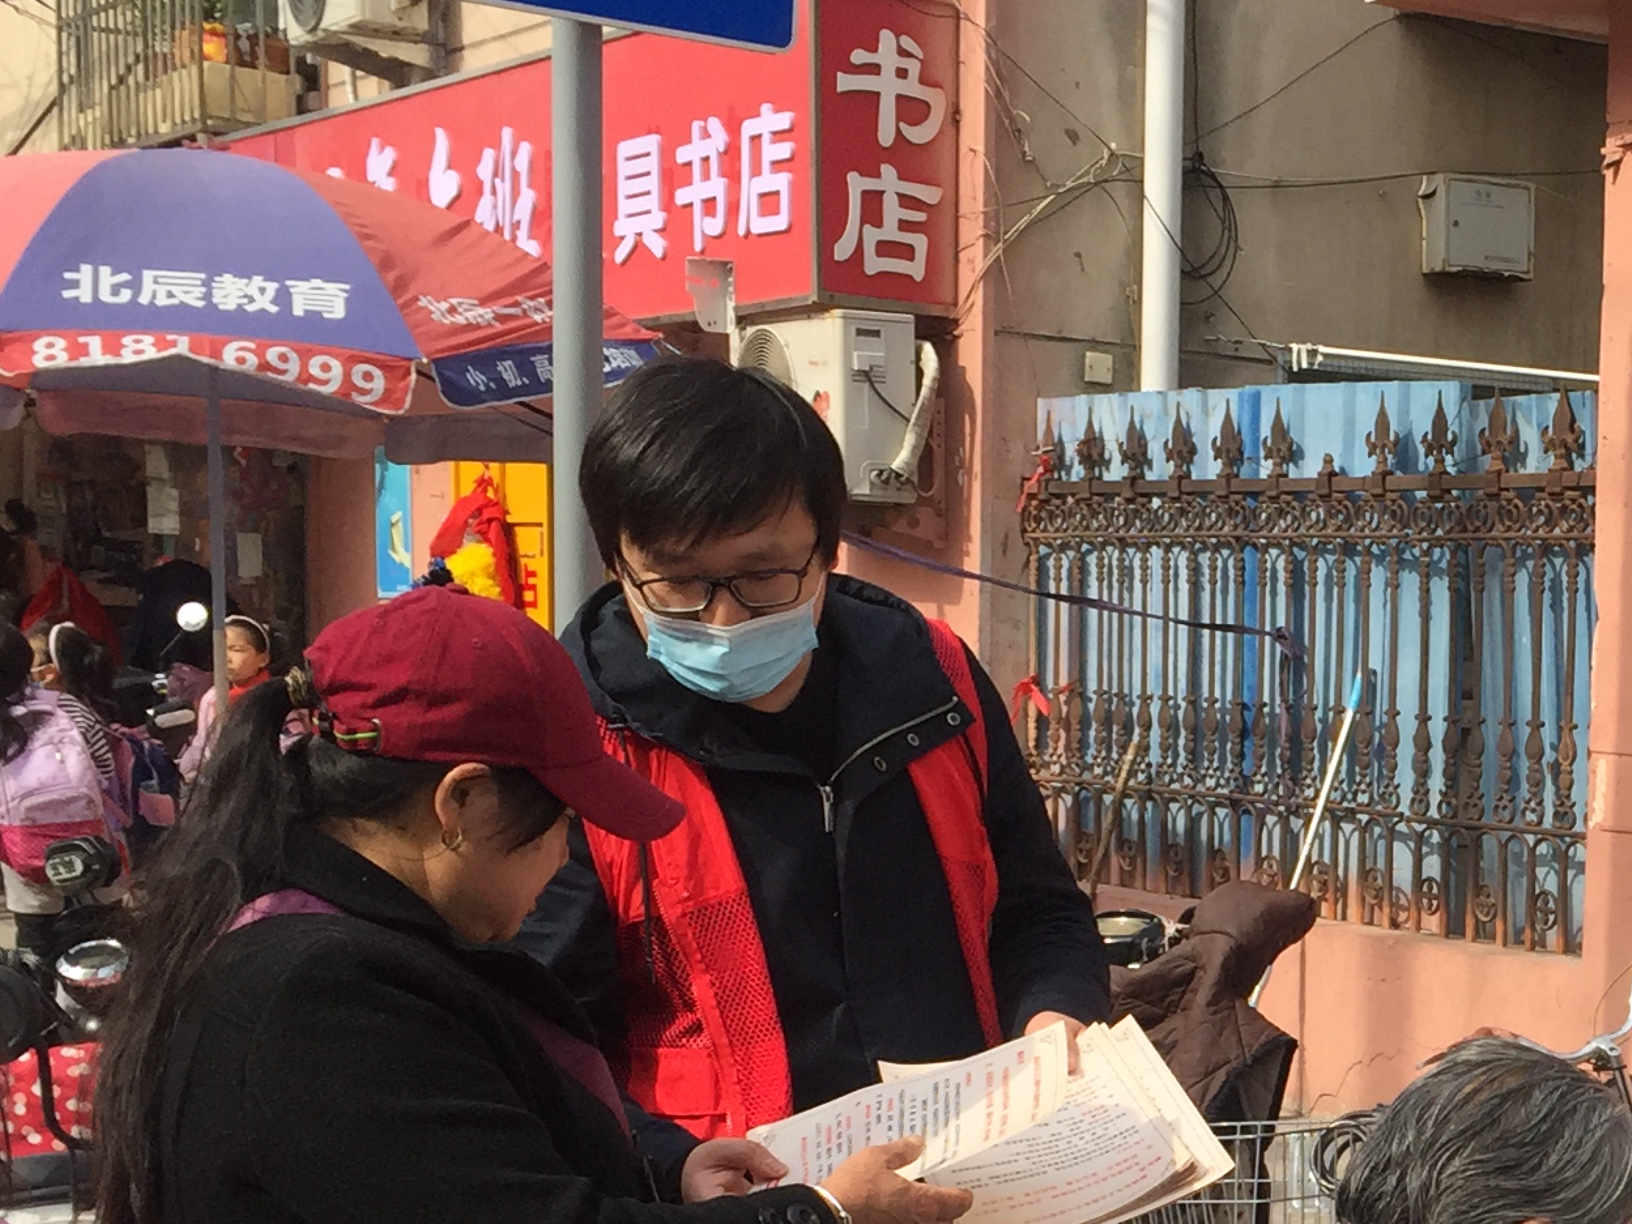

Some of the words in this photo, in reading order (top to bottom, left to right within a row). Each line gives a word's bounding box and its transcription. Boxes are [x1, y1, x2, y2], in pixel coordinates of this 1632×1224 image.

[834, 28, 945, 282] 书店
[61, 263, 351, 319] 北辰教育
[222, 341, 386, 403] 6999
